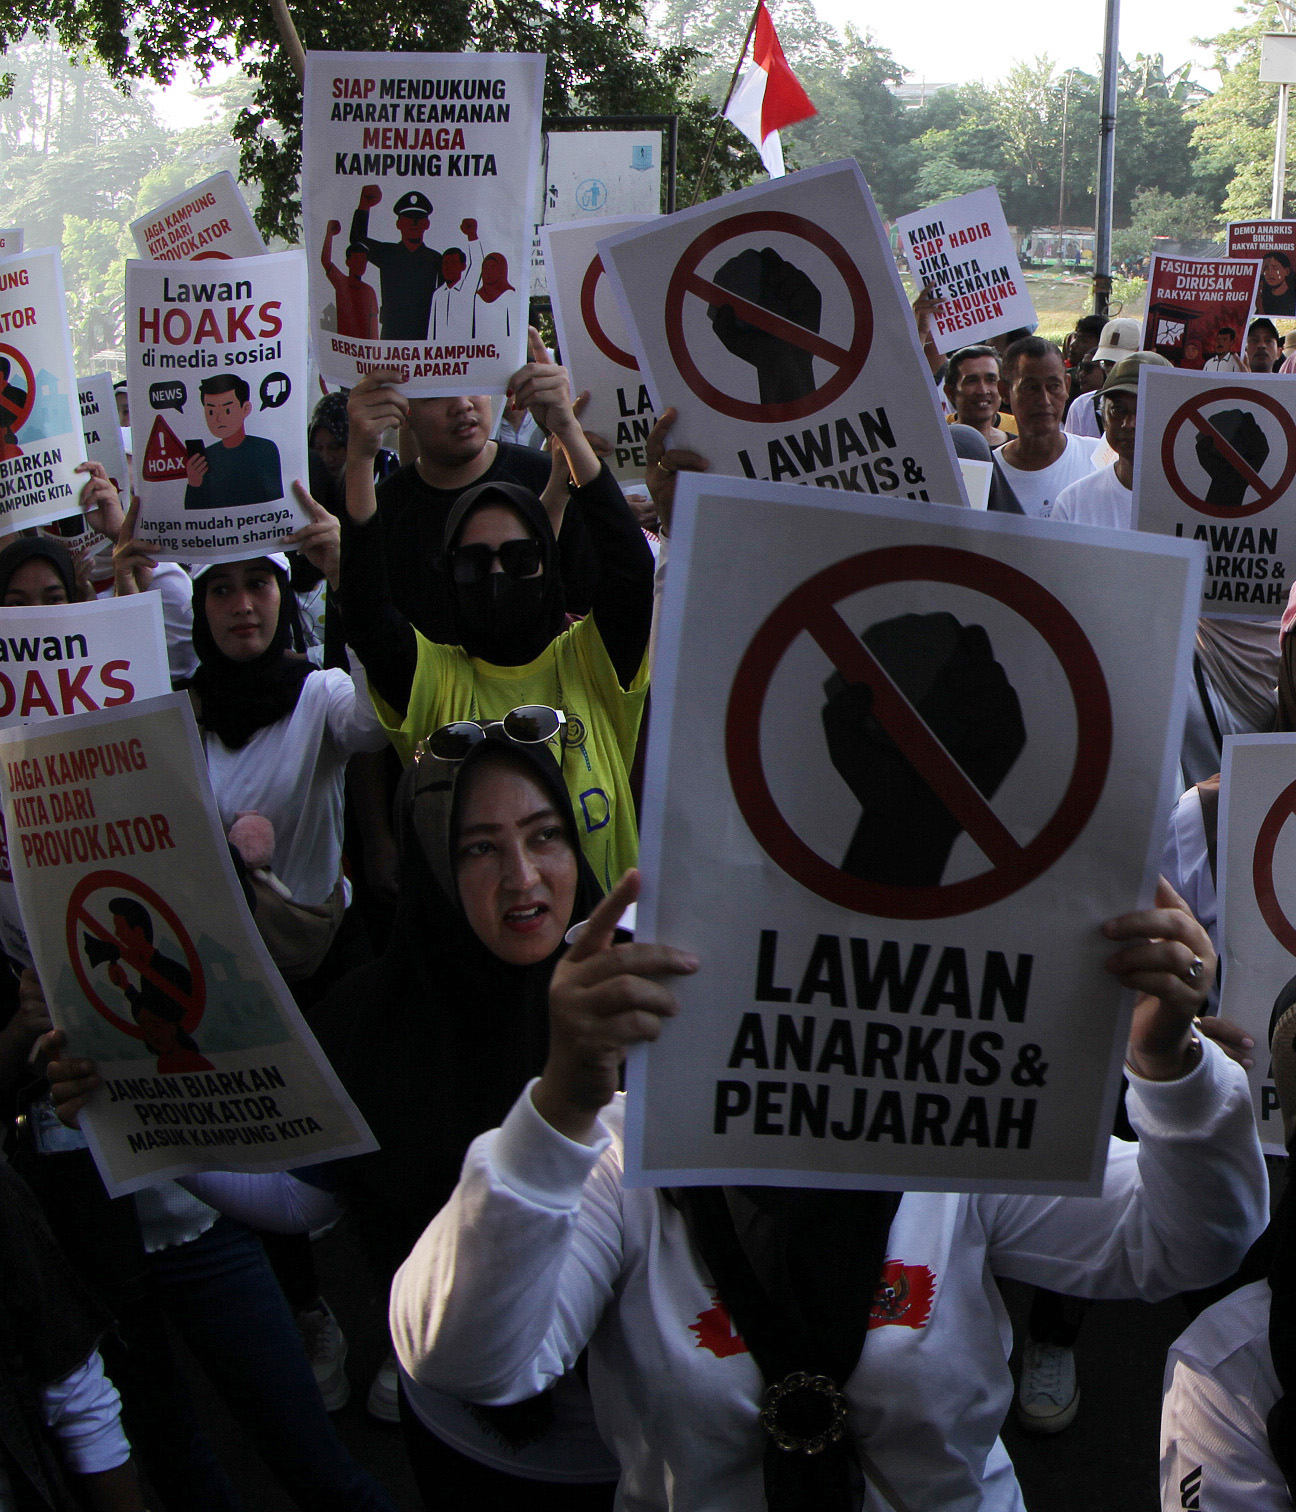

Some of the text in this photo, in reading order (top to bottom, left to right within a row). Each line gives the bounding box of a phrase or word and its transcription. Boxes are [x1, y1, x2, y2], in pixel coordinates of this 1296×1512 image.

[332, 77, 506, 100] SIAP MENDUKUNG
[330, 102, 510, 123] APARAT KEAMANAN
[362, 127, 466, 150] MENJAGA
[335, 152, 498, 177] KAMPUNG KITA
[143, 192, 217, 242] JAGA KAMPUNG
[1234, 225, 1293, 236] DEMO ANARKIS
[148, 223, 193, 256] KITA DARI
[908, 220, 946, 246] KAMI
[912, 222, 992, 261] SIAP HADIR
[1252, 234, 1274, 242] BIKIN
[1231, 243, 1295, 251] RAKYAT MENANGIS
[918, 253, 950, 276] JIKA
[1160, 260, 1254, 277] FASILITAS UMUM
[163, 277, 253, 303] Lawan
[948, 266, 1011, 299] SENAYAN
[1156, 288, 1249, 302] RAKYAT YANG RUGI
[1176, 275, 1234, 290] DIRUSAK
[138, 301, 283, 346] HOAKS
[937, 302, 1004, 336] PRESIDEN
[142, 340, 282, 368] di media sosial
[331, 338, 500, 361] BERSATU JAGA KAMPUNG,
[413, 361, 469, 378] APARAT
[152, 388, 183, 402] NEWS
[737, 406, 898, 483] LAWAN
[1, 448, 62, 479] BIARKAN
[148, 456, 186, 473] HOAX
[902, 456, 927, 485] &
[0, 484, 73, 515] AMPUNG KITA
[140, 508, 294, 533] Jangan mudah percaya,
[182, 533, 239, 548] sebelum
[1271, 561, 1286, 579] &
[1204, 580, 1282, 605] JARAH
[0, 633, 88, 662] awan
[7, 738, 148, 792] JAGA KAMPUNG
[12, 788, 97, 828] KITA DARI
[20, 813, 176, 868] PROVOKATOR
[755, 929, 1034, 1024] LAWAN
[727, 1012, 1049, 1088] ANARKIS &
[105, 1065, 287, 1102] JANGAN BIARKAN
[133, 1095, 282, 1126] PROVOKATOR
[713, 1079, 1037, 1150] PENJARAH
[126, 1116, 323, 1154] MASUK KAMPUNG KITA
